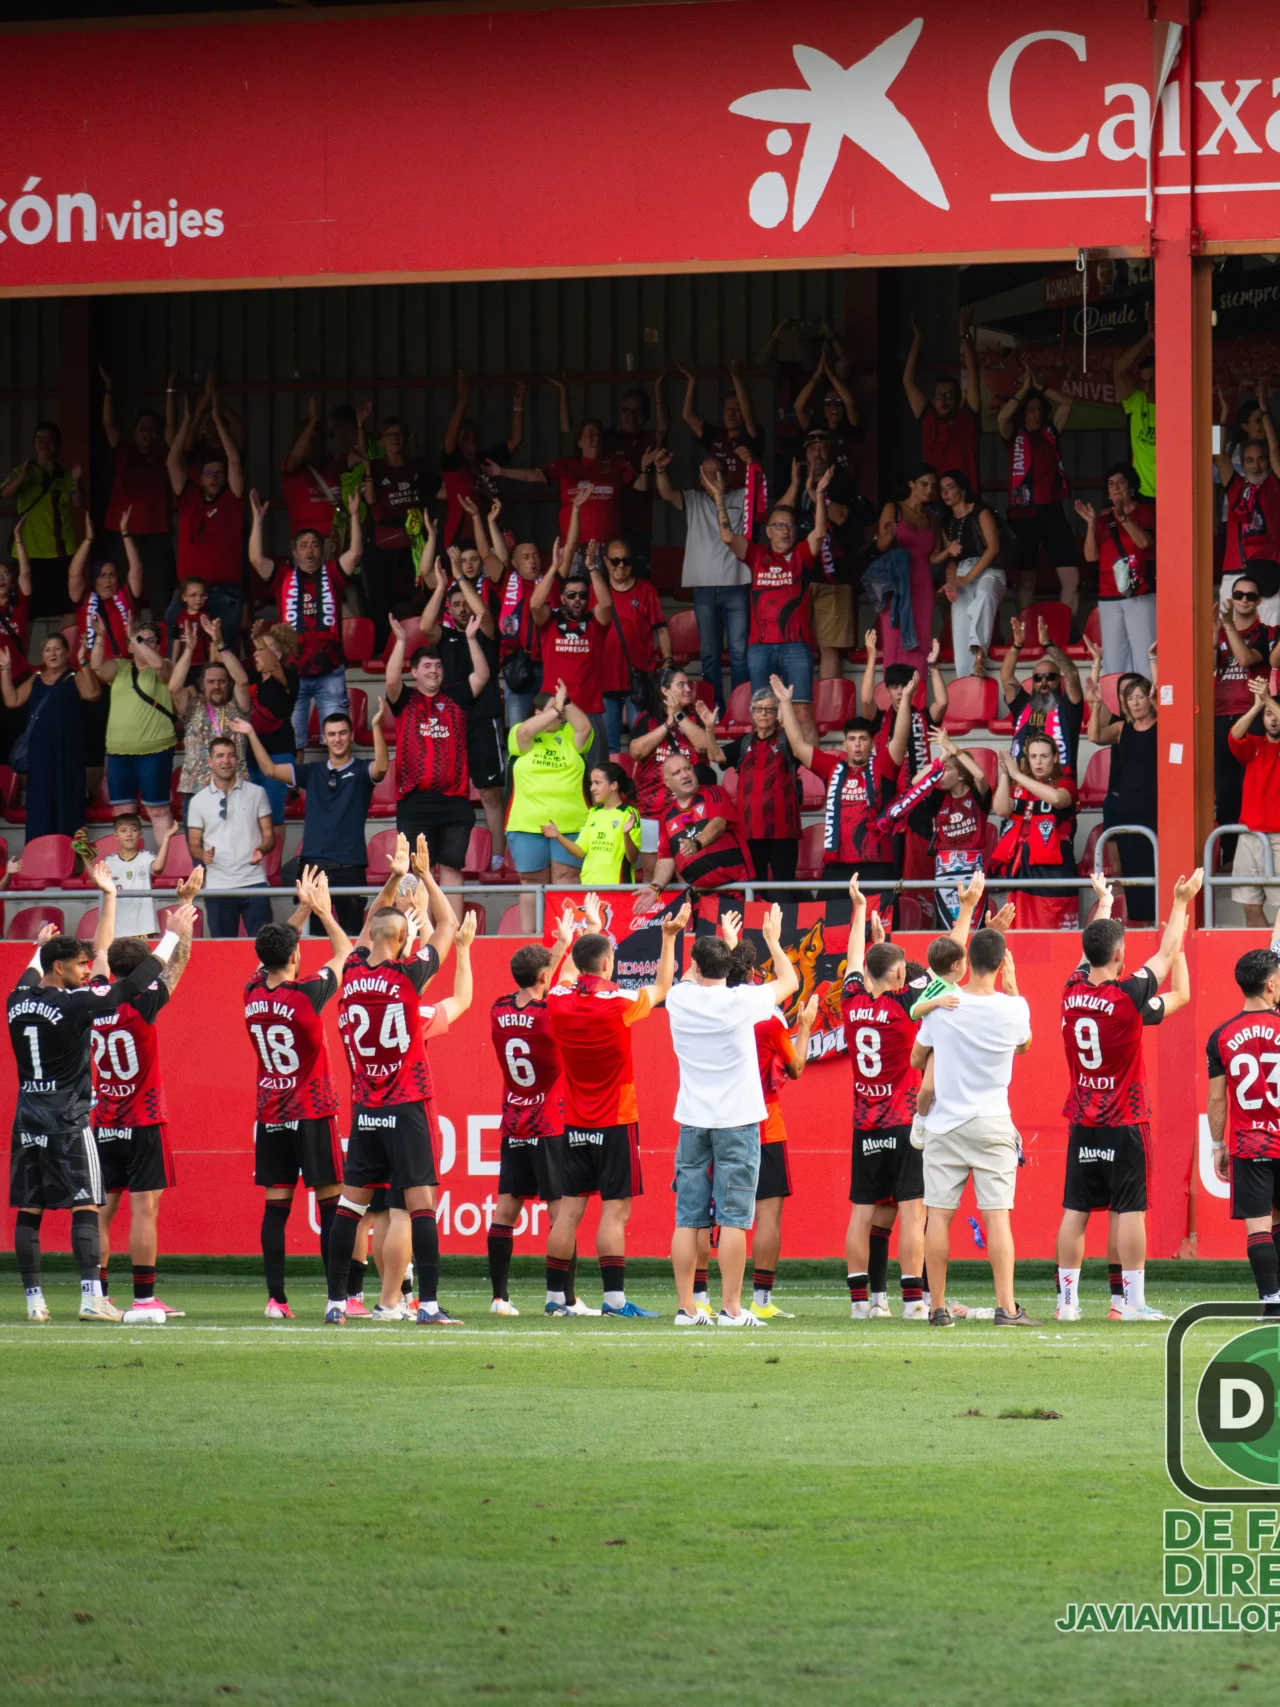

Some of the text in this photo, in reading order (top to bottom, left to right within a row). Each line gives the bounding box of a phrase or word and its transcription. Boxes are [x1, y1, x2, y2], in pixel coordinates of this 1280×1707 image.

[0, 176, 225, 247] ón viajes
[1219, 285, 1280, 310] siempre
[753, 571, 792, 579] MIRANDA
[753, 577, 793, 586] EMPRESAS
[505, 571, 521, 605] ¡AUP
[555, 638, 590, 647] MIRANDA
[555, 645, 590, 653] EMPRESAS
[656, 747, 690, 756] MIRDA
[911, 712, 925, 774] KEMAN
[532, 759, 568, 768] EMPRESAS
[841, 793, 868, 802] PRESAS
[842, 786, 868, 795] RANDA
[629, 916, 666, 931] Mirand
[617, 960, 680, 976] KOMANO
[342, 976, 400, 999] JOAQUÍN F.
[273, 1001, 296, 1021] VAL
[875, 1010, 890, 1024] M.
[496, 1013, 534, 1029] VERDE
[348, 1003, 411, 1057] 24
[1074, 1017, 1102, 1070] 9
[1226, 1026, 1274, 1052] DORRIO
[22, 1025, 43, 1080] 1
[91, 1028, 139, 1081] 20
[249, 1023, 300, 1075] 18
[854, 1026, 883, 1078] 8
[504, 1037, 537, 1088] 6
[258, 1076, 297, 1090] IZADI
[1078, 1073, 1115, 1090] IZADI
[358, 1113, 397, 1130] Alucoil
[21, 1131, 49, 1149] Aloil
[569, 1130, 605, 1147] Alucoil
[862, 1137, 897, 1152] Alucoil
[1077, 1146, 1116, 1162] Alucoil
